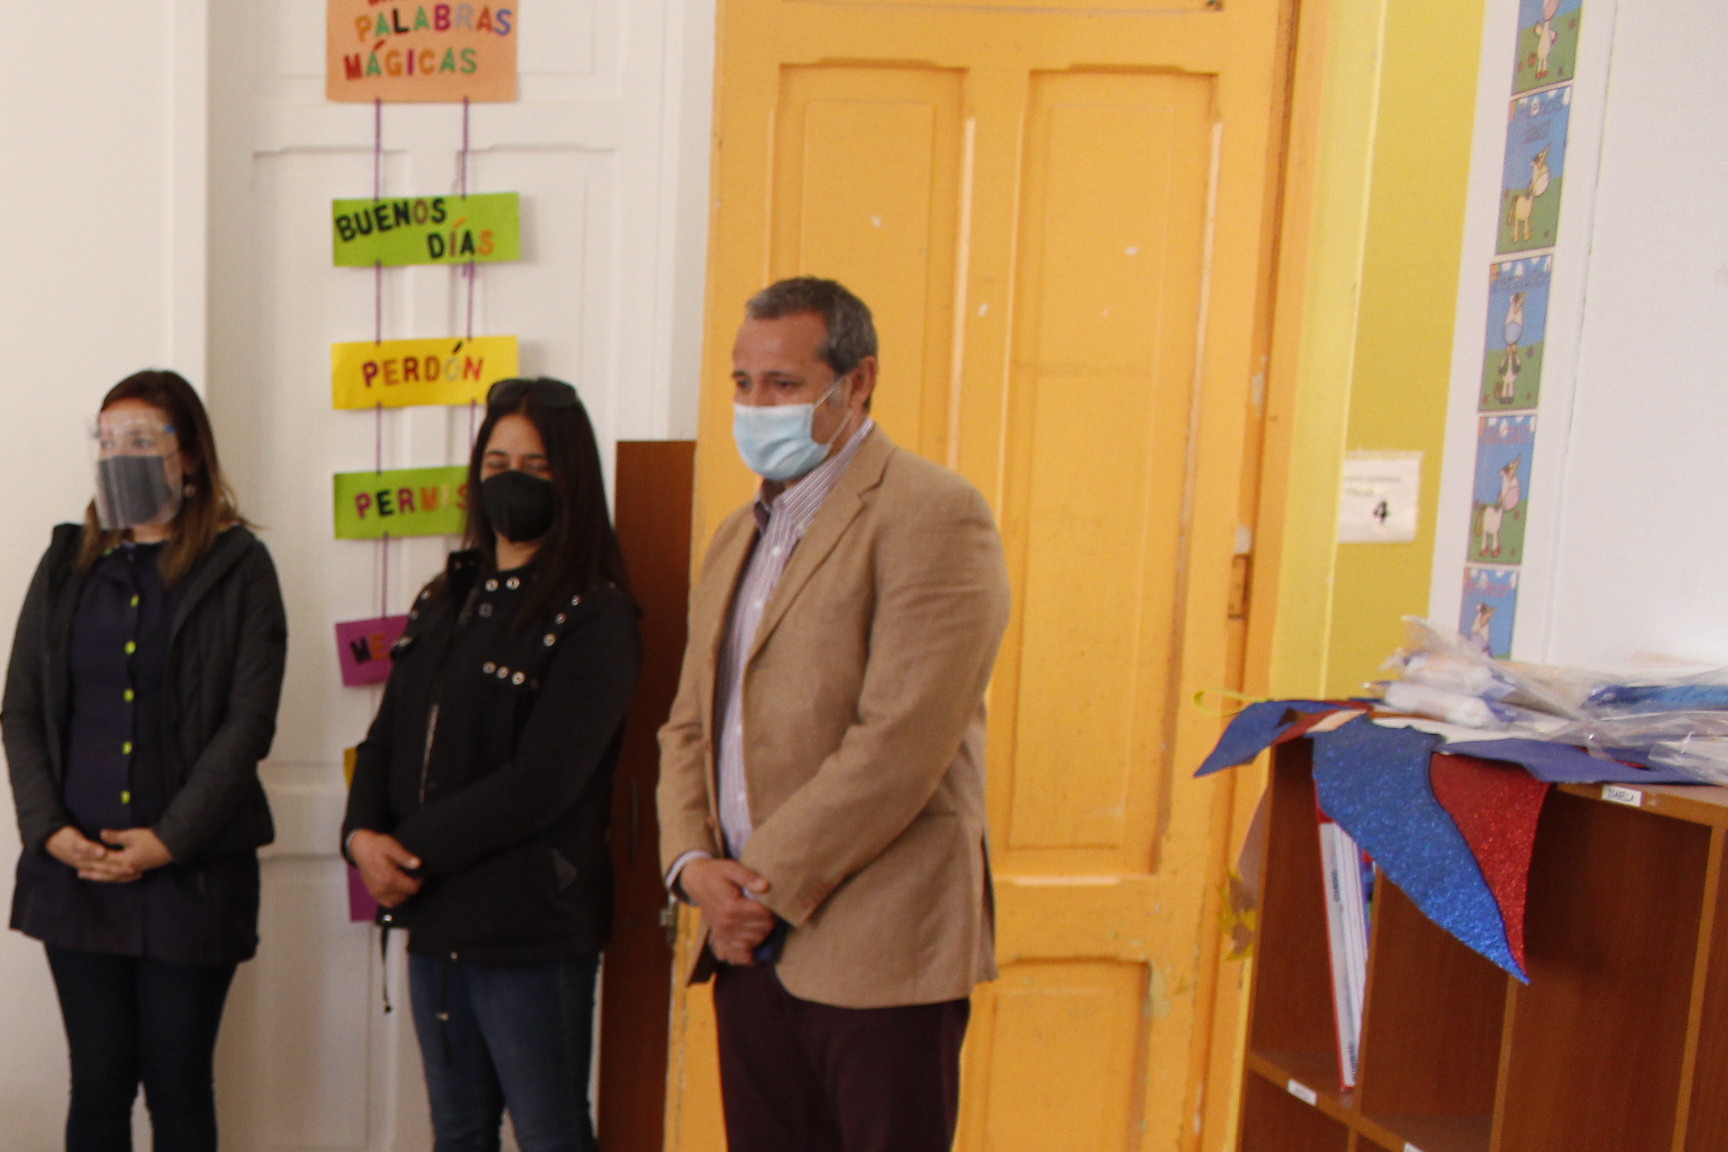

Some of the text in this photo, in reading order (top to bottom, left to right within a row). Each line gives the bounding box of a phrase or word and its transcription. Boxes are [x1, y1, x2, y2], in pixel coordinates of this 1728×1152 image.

[355, 4, 512, 42] PALABRAS
[343, 39, 478, 81] MÁGICAS
[335, 198, 447, 242] BUENOS
[427, 216, 495, 259] DÍAS
[362, 341, 484, 387] PERDÓN
[1373, 500, 1389, 526] 4
